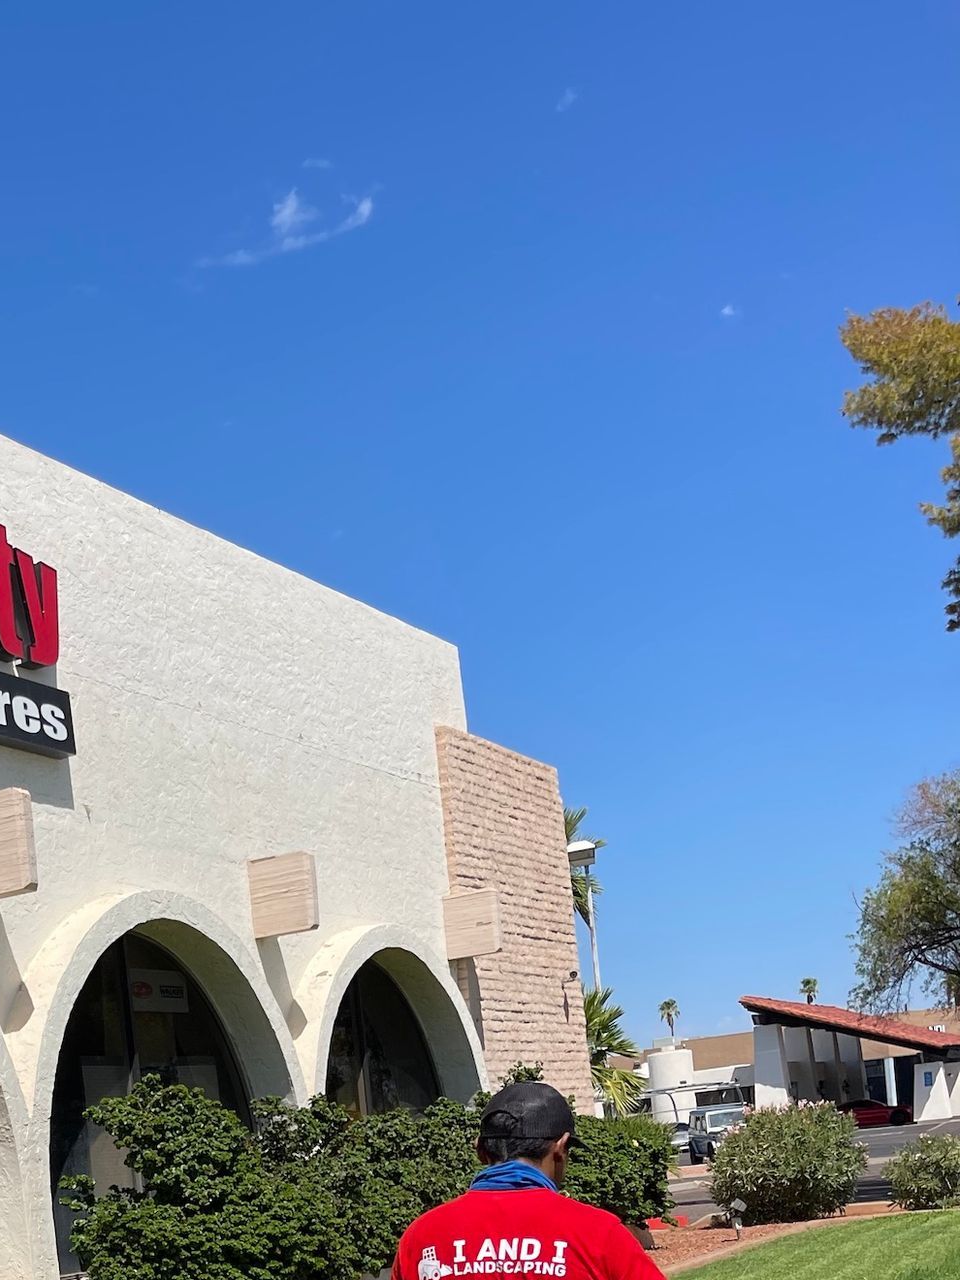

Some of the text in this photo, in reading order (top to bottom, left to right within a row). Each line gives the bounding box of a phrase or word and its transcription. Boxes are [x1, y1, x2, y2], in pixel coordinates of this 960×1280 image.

[453, 1238, 567, 1264] I AND I
[453, 1261, 567, 1277] LANDSCAPING
